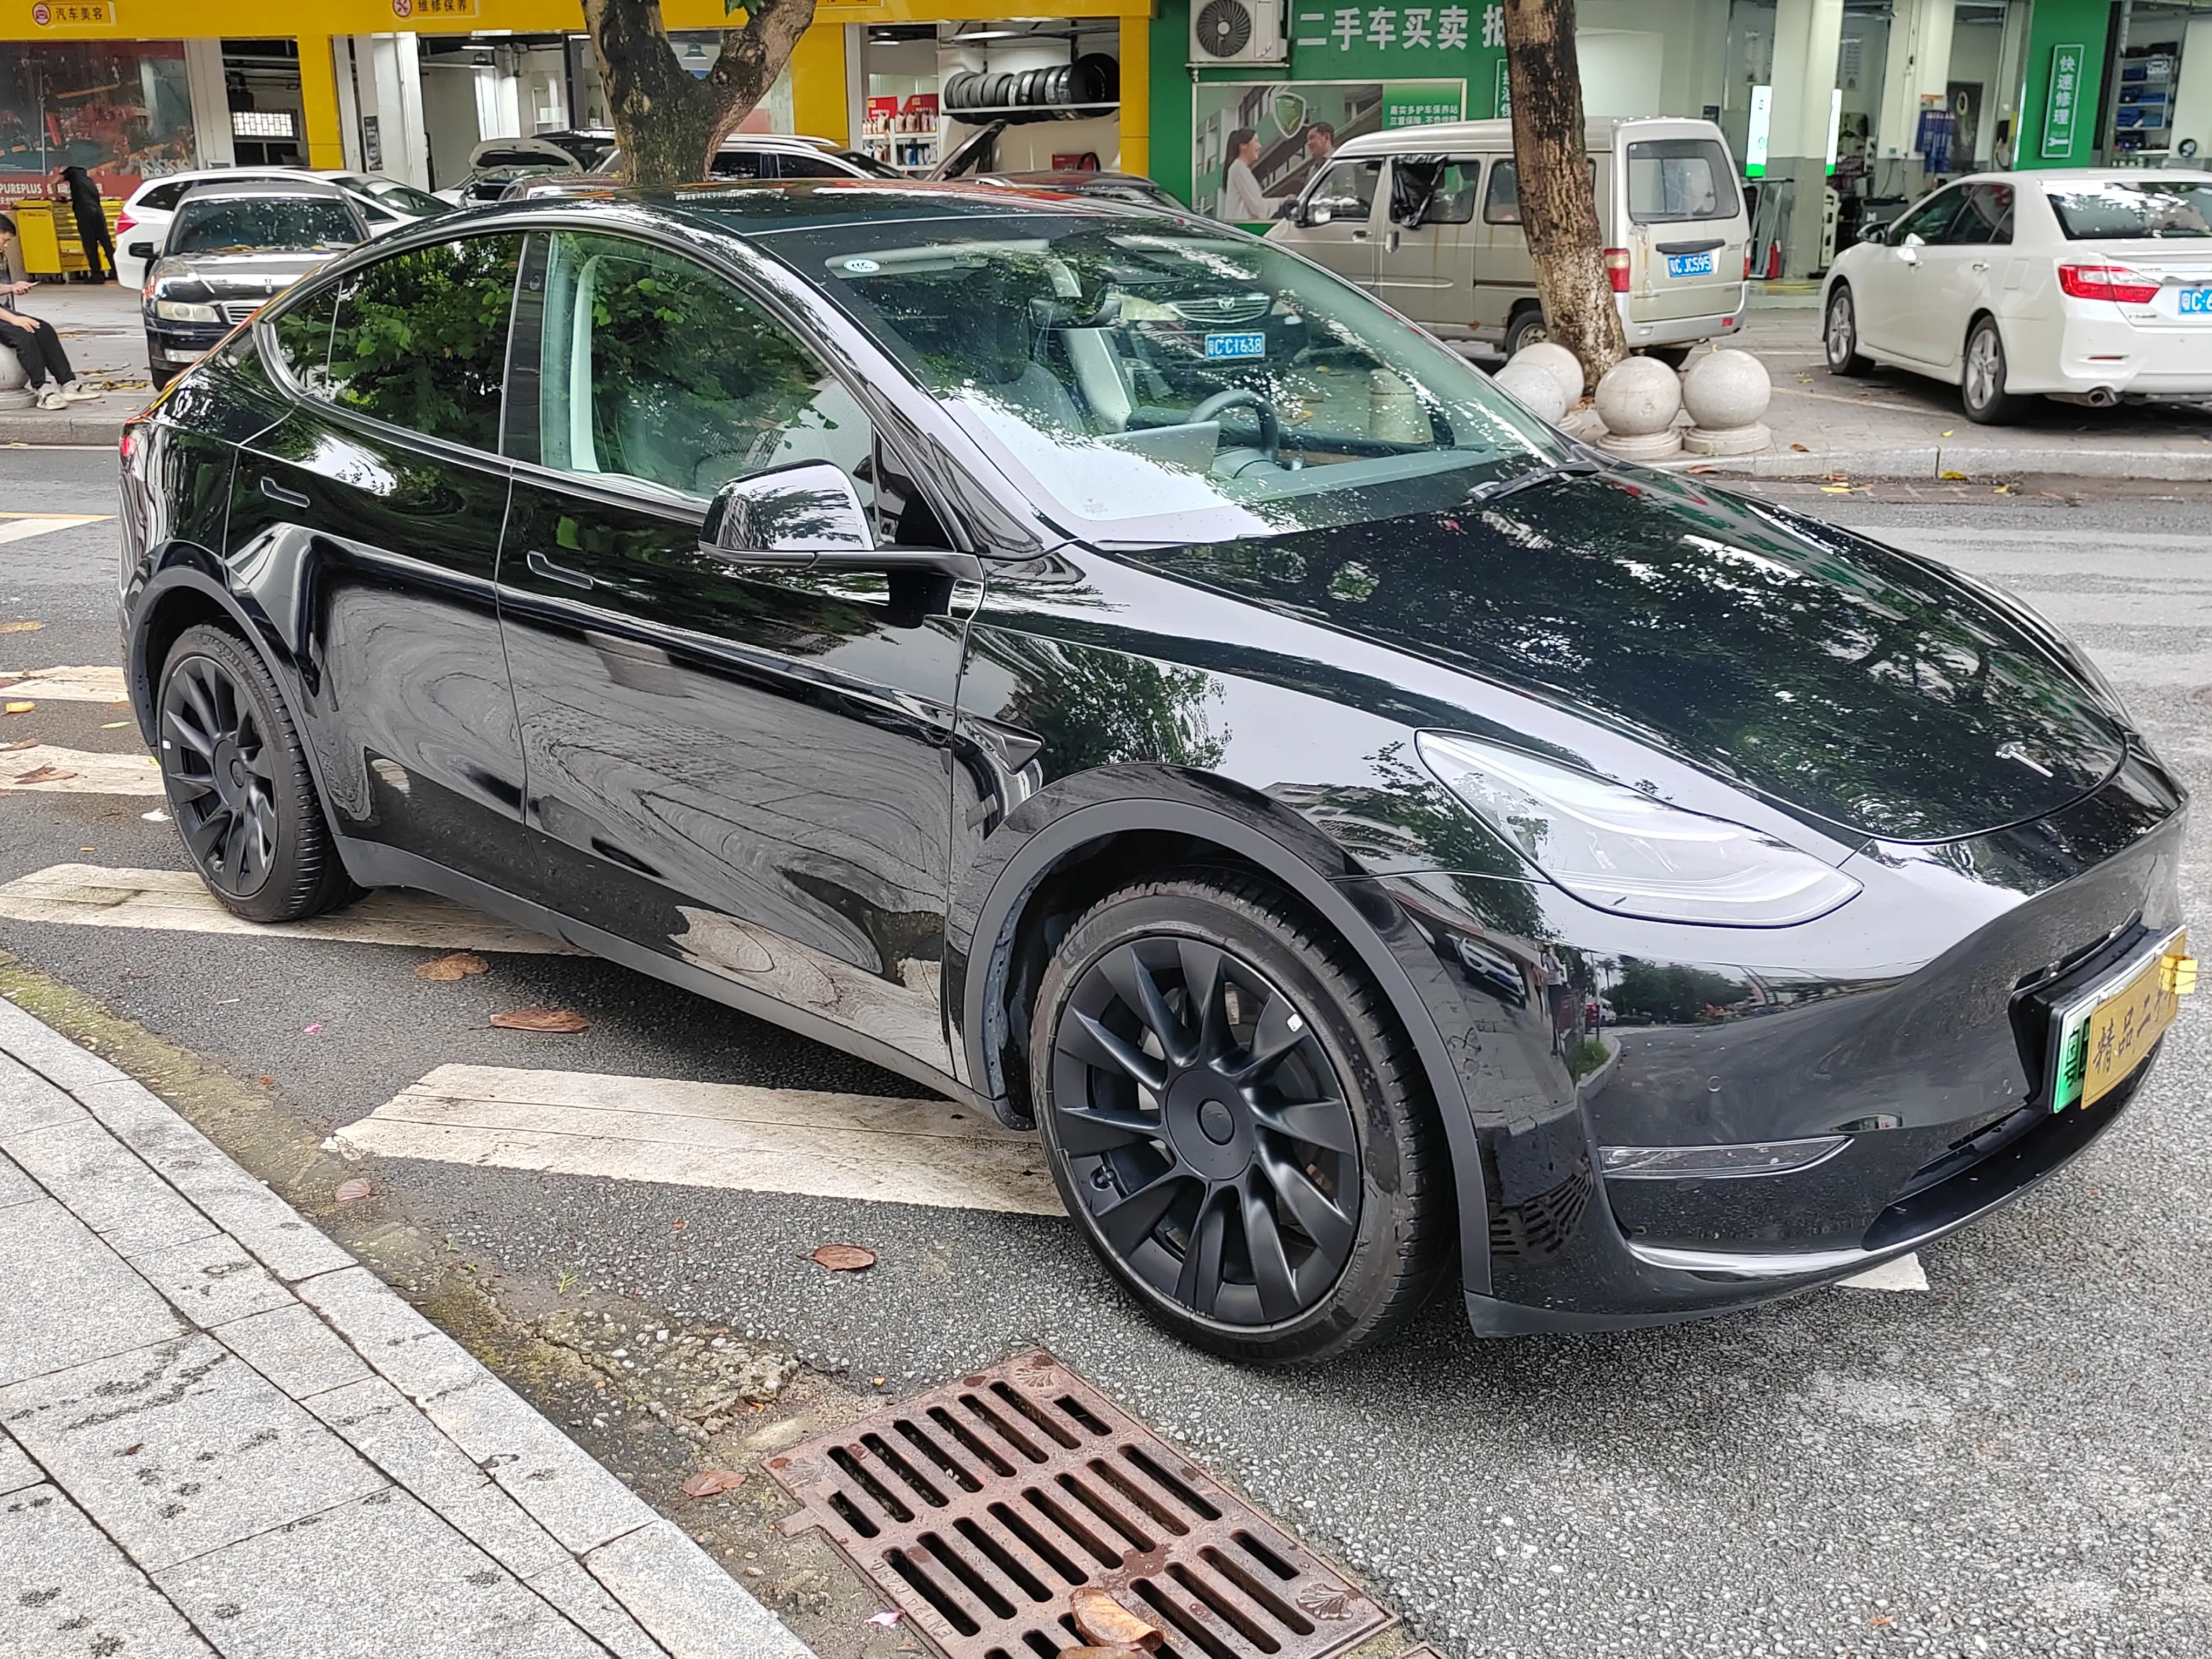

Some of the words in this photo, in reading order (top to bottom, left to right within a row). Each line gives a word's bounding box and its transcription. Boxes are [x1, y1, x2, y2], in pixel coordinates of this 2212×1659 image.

[56, 6, 103, 21] 汽车美容
[1297, 4, 1468, 51] 二手车买卖
[2053, 55, 2075, 125] 快速修理
[0, 183, 42, 194] PUREPLUS
